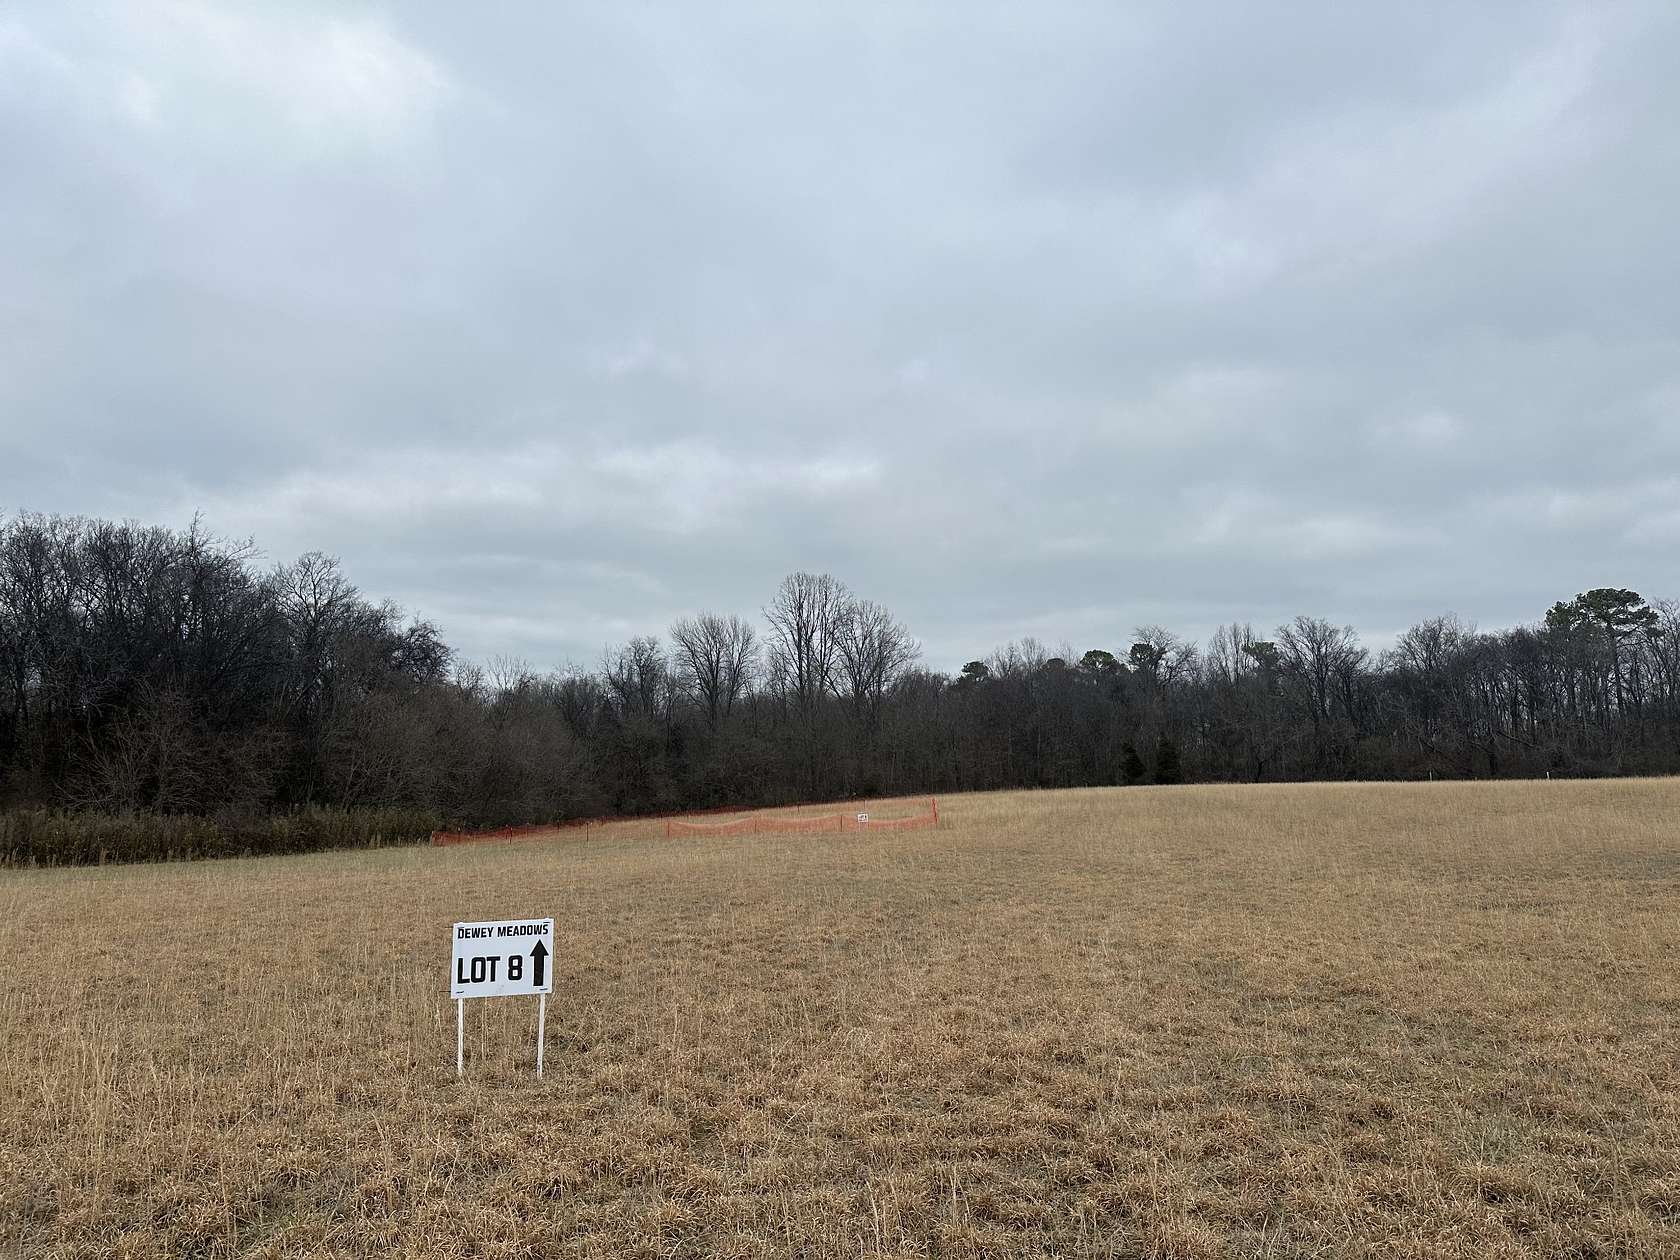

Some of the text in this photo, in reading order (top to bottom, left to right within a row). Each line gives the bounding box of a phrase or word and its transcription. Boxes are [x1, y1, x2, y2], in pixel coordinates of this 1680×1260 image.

[458, 924, 549, 939] DEWEY MEADOWS
[458, 955, 523, 984] LOT 8
